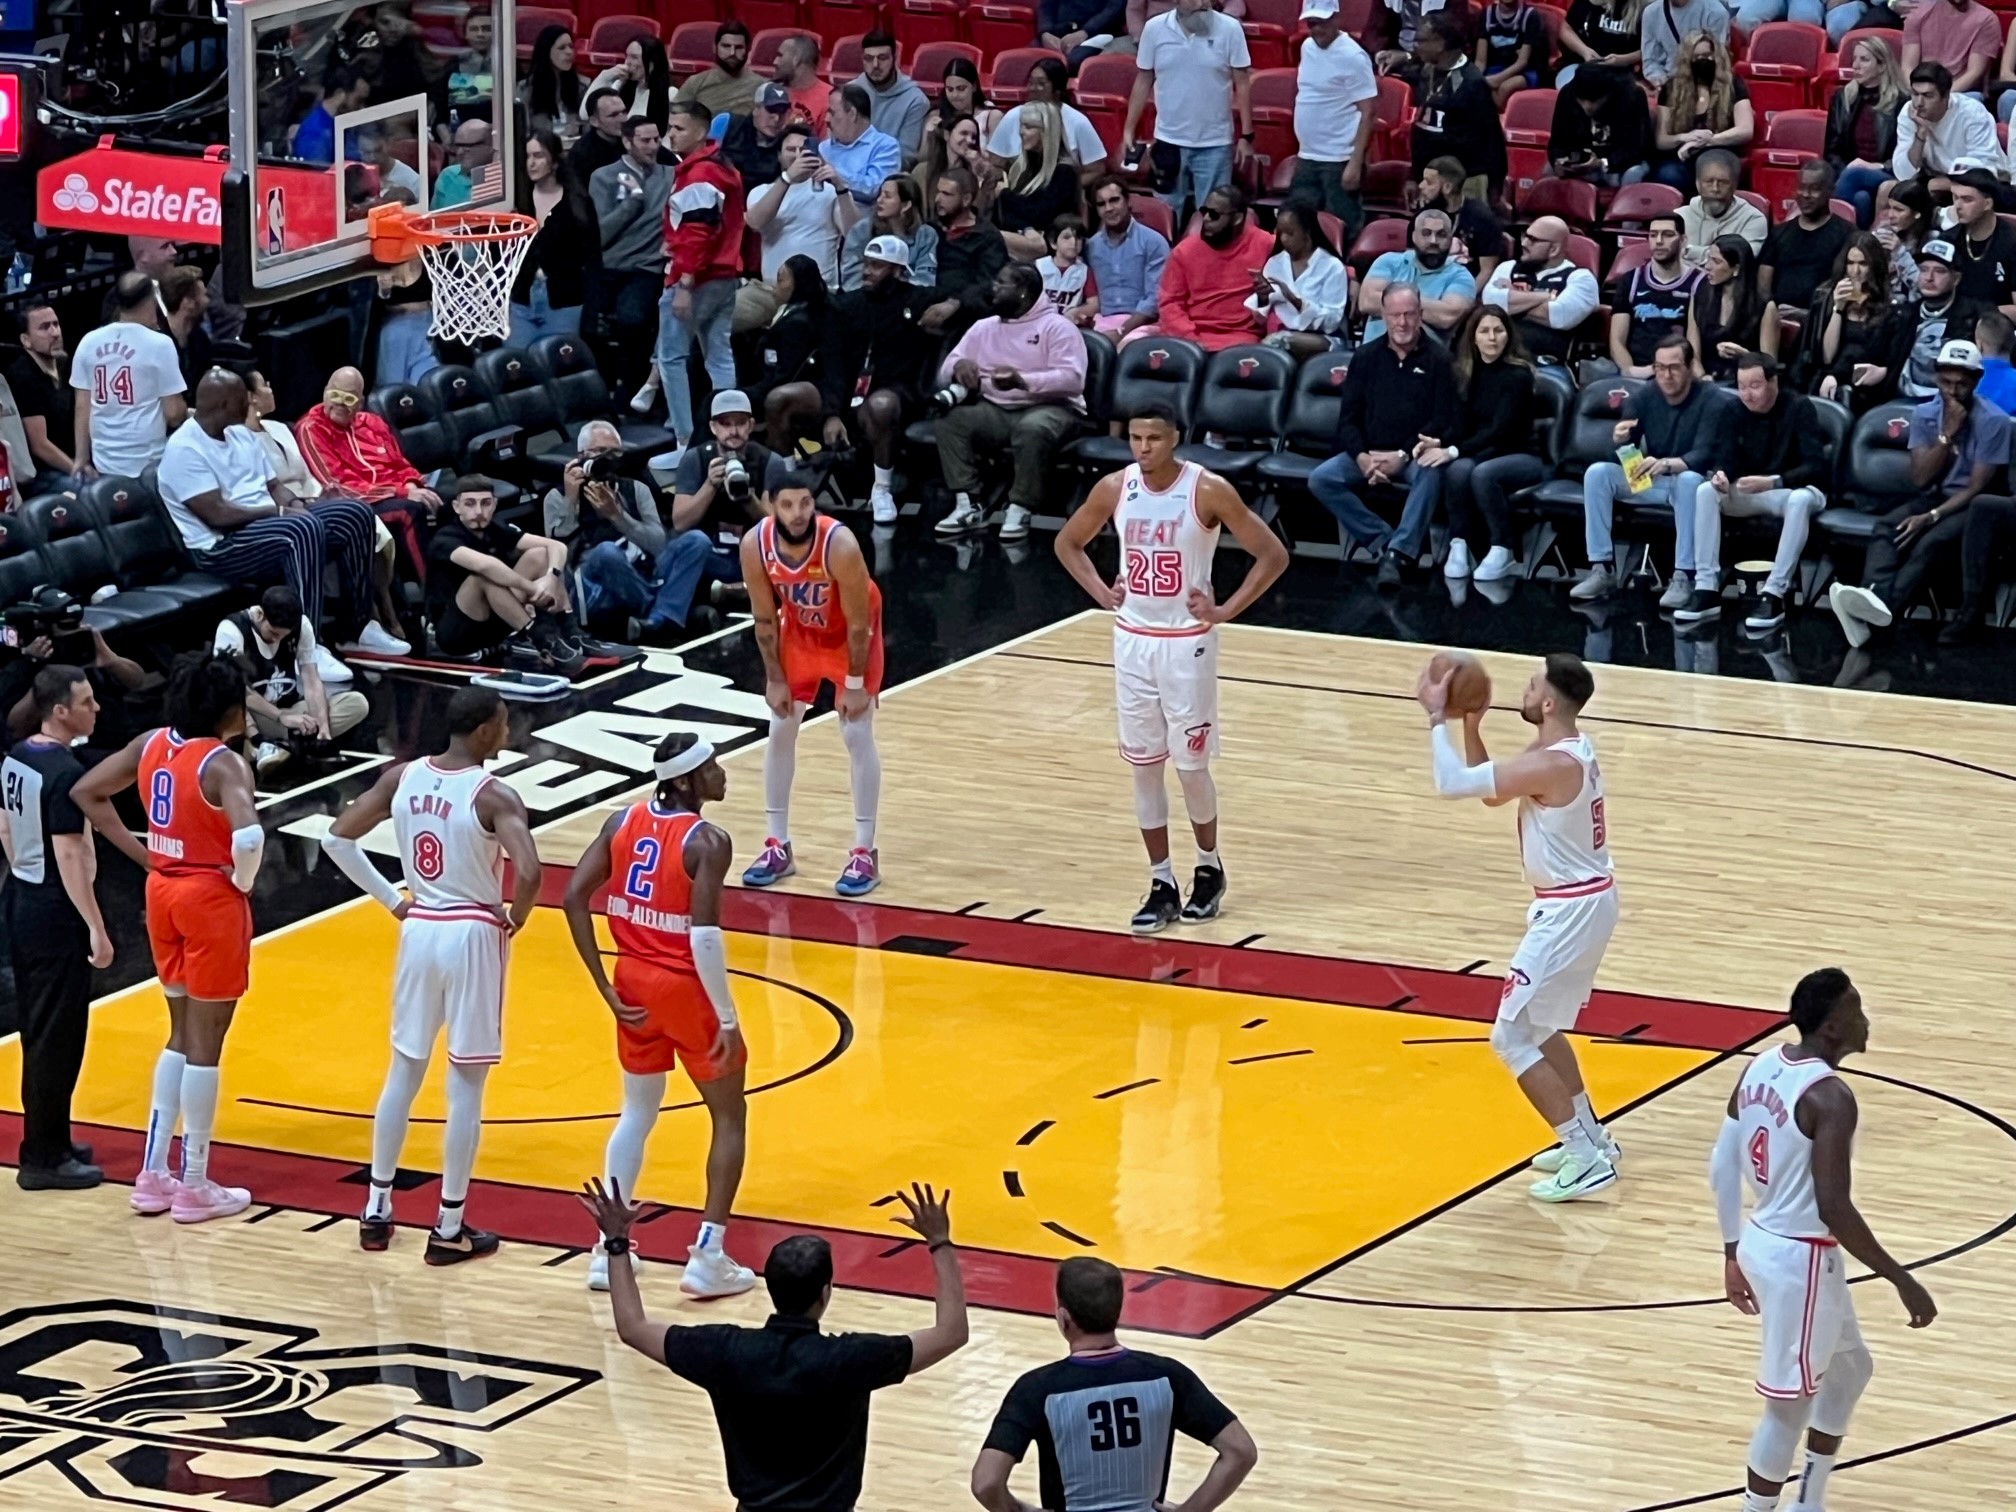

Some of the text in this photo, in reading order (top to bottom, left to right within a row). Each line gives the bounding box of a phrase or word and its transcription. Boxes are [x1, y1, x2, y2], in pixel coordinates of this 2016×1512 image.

[101, 179, 222, 226] StateFa
[95, 365, 134, 405] 14
[1124, 510, 1185, 547] HEAT
[1126, 548, 1182, 597] 25
[7, 771, 24, 817] 24
[151, 768, 174, 828] 8
[409, 794, 453, 821] CAIN
[413, 830, 443, 882] 8
[625, 837, 660, 902] 2
[1748, 1125, 1769, 1185] 4
[1087, 1396, 1142, 1452] 36
